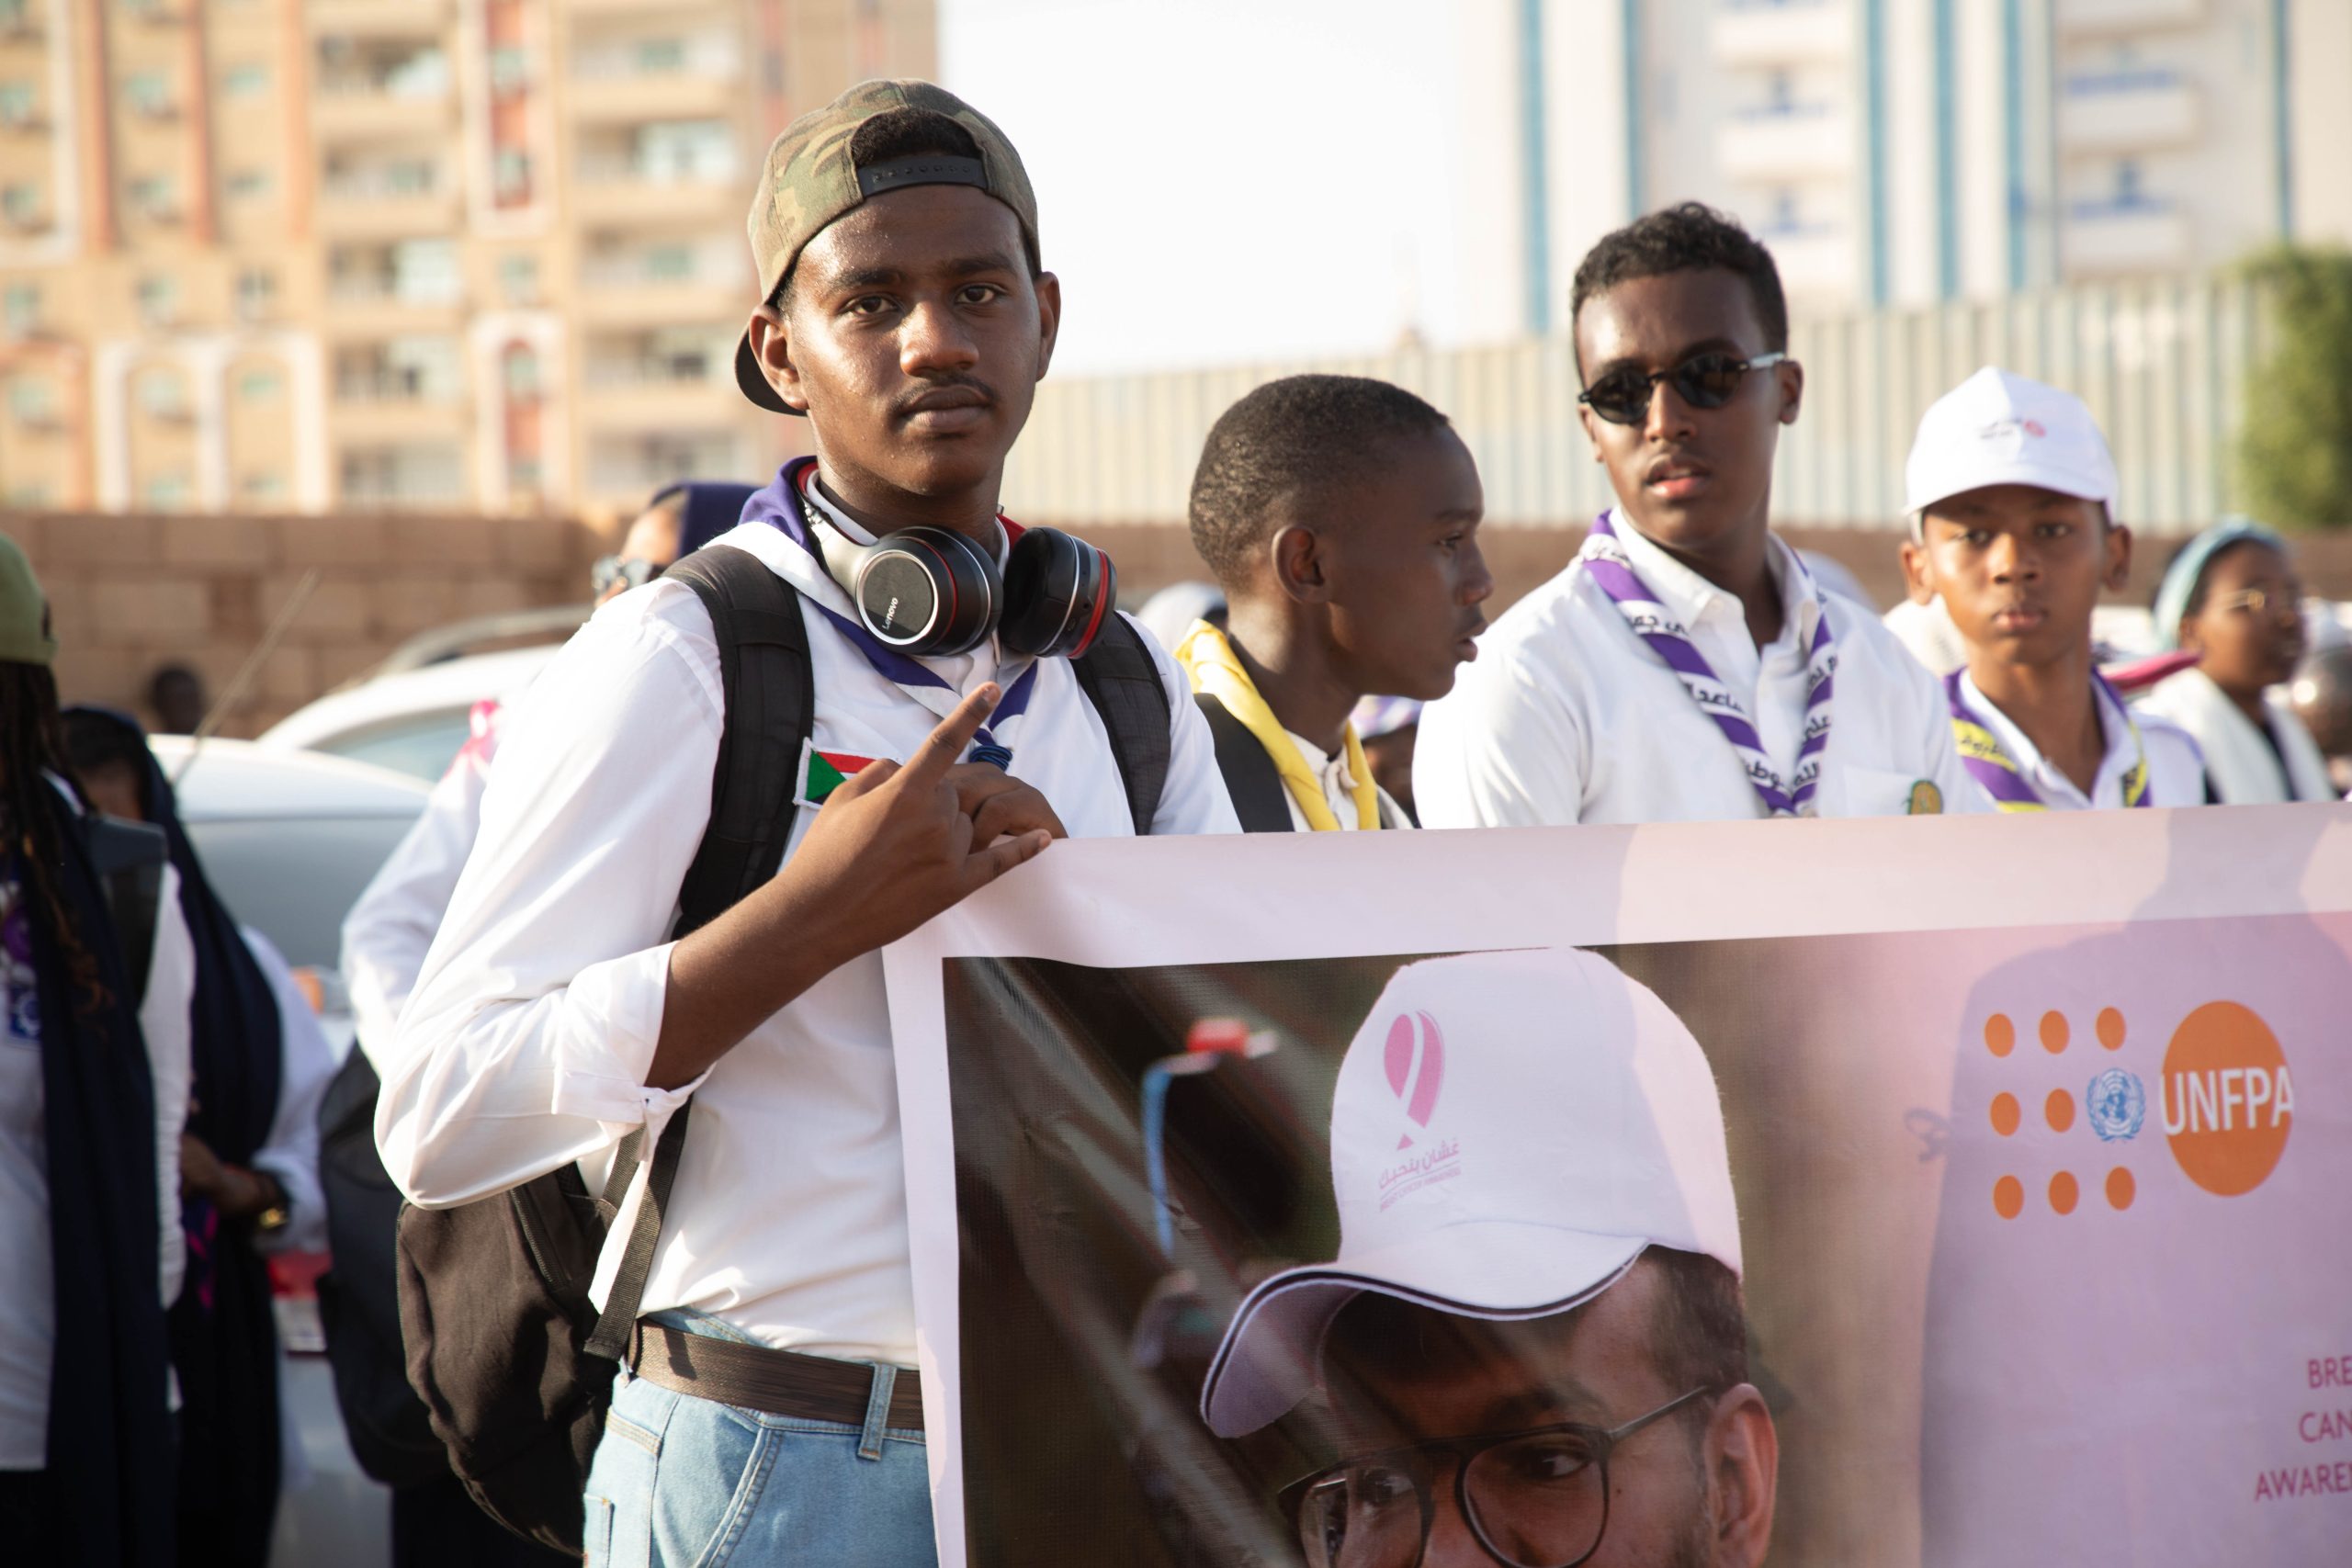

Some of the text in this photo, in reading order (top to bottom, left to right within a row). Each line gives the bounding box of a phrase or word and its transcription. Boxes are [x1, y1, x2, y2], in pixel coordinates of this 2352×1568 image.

[882, 597, 899, 630] Lenovo
[2159, 1066, 2295, 1136] UNFPA
[2254, 1461, 2352, 1503] AWARE
